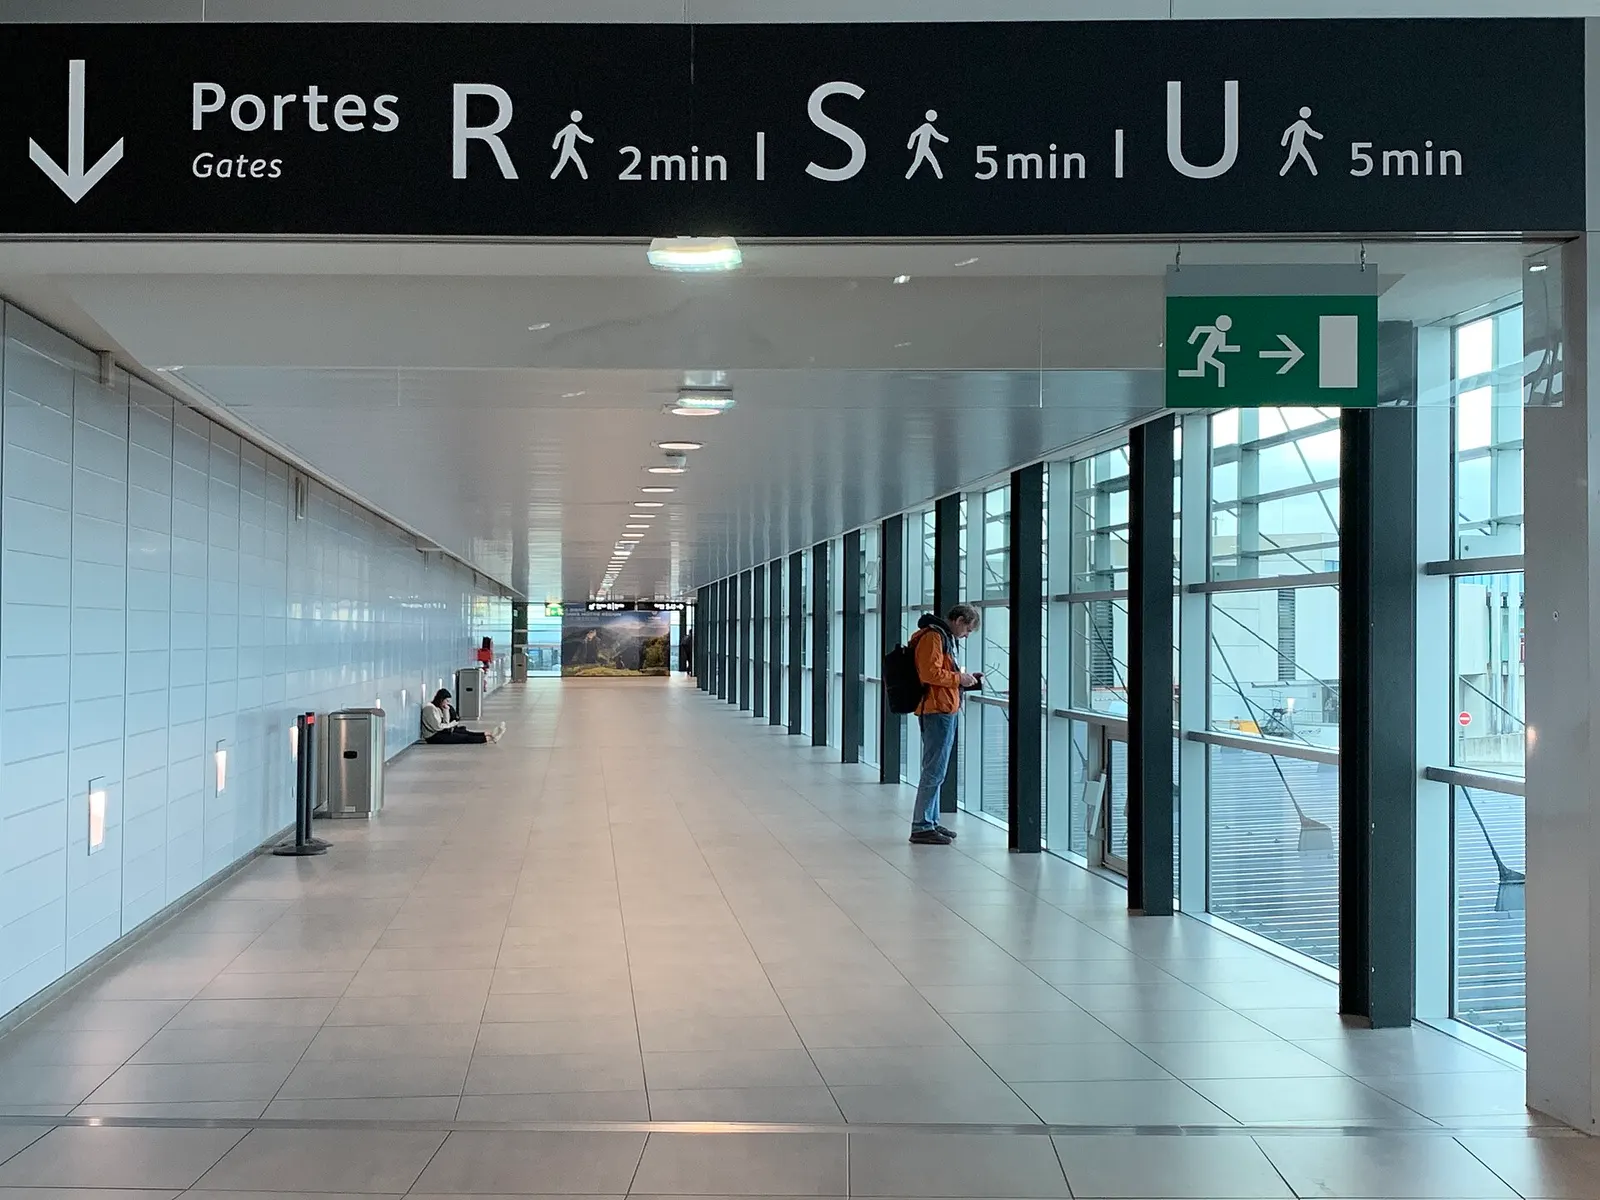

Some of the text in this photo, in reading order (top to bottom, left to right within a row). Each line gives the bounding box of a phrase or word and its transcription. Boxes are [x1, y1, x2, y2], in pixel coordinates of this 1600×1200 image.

[192, 80, 1462, 182] Portes R 2min S 5min U 5min
[192, 152, 283, 179] Gates
